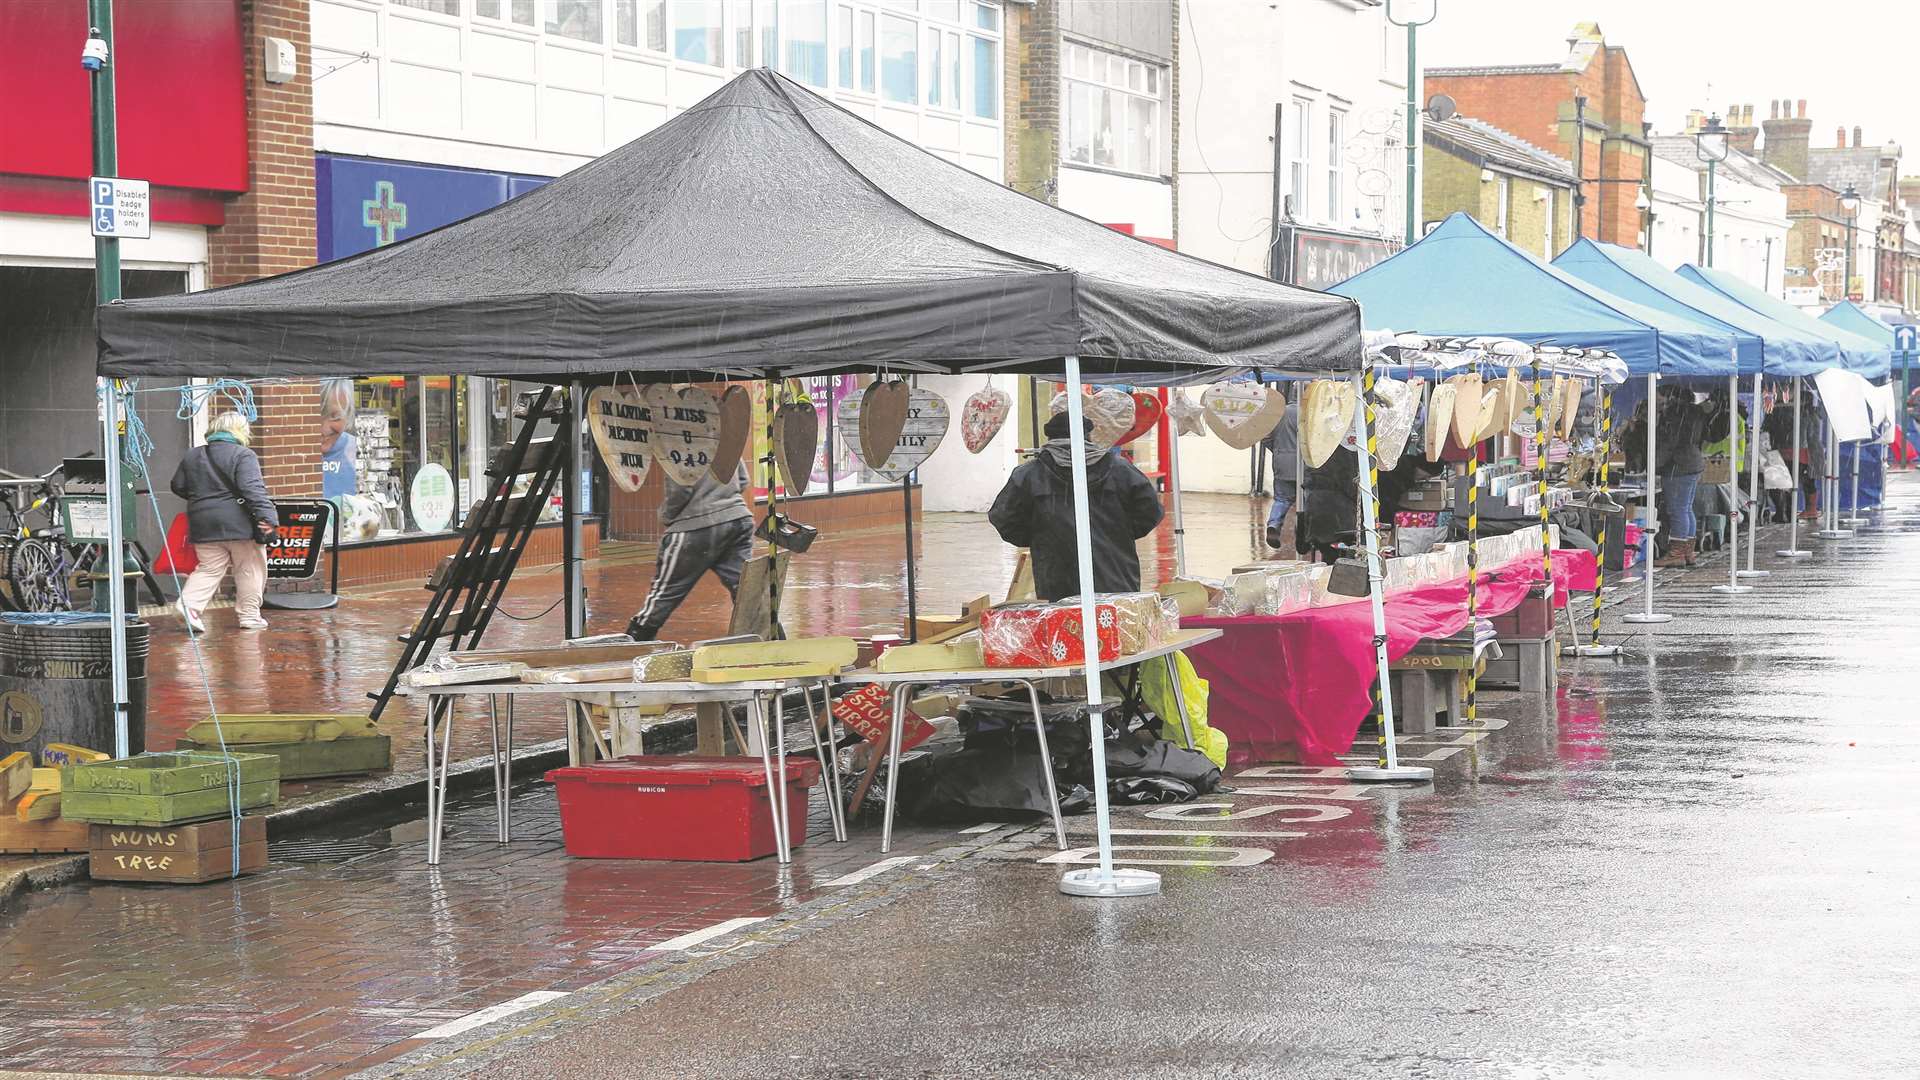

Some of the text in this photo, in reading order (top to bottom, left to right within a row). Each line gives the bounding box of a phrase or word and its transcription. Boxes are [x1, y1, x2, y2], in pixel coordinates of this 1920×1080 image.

[98, 183, 111, 204] P
[116, 190, 147, 199] Disabled
[120, 200, 141, 209] badge
[118, 209, 145, 218] holders
[124, 219, 139, 228] only
[616, 403, 651, 422] LOVING
[663, 406, 706, 424] I MISS
[608, 425, 648, 443] MEMORY
[670, 449, 708, 467] DAD
[275, 526, 314, 538] REE
[283, 538, 311, 548] USE
[267, 548, 310, 558] ASH
[43, 660, 85, 678] SWALE
[85, 660, 113, 677] Tid
[834, 703, 882, 740] HERE
[110, 831, 178, 847] MUMS
[114, 855, 173, 871] TREE
